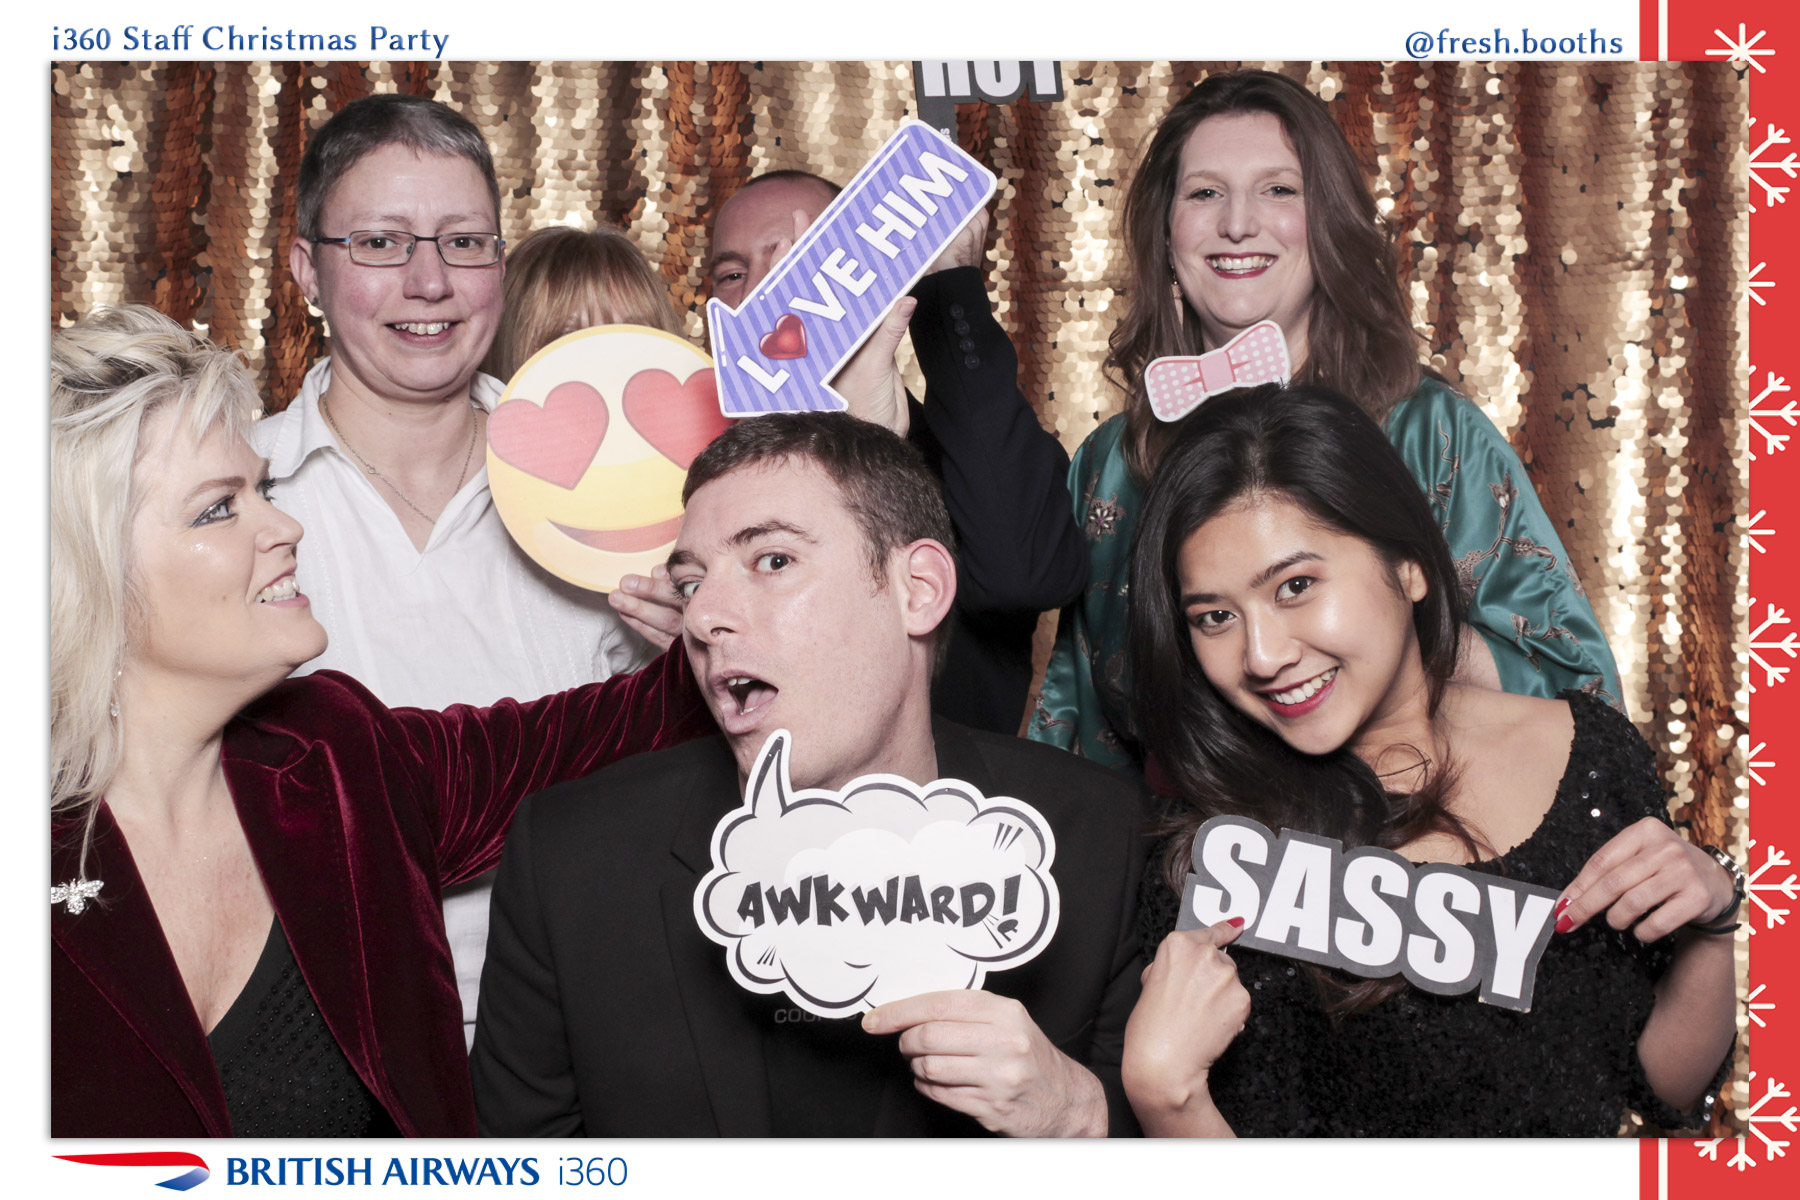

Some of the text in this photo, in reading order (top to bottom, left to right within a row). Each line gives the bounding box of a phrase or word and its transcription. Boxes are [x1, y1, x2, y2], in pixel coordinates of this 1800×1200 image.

[855, 151, 969, 260] HIM
[736, 873, 1022, 942] AWKWARD!
[1192, 823, 1556, 999] SASSY
